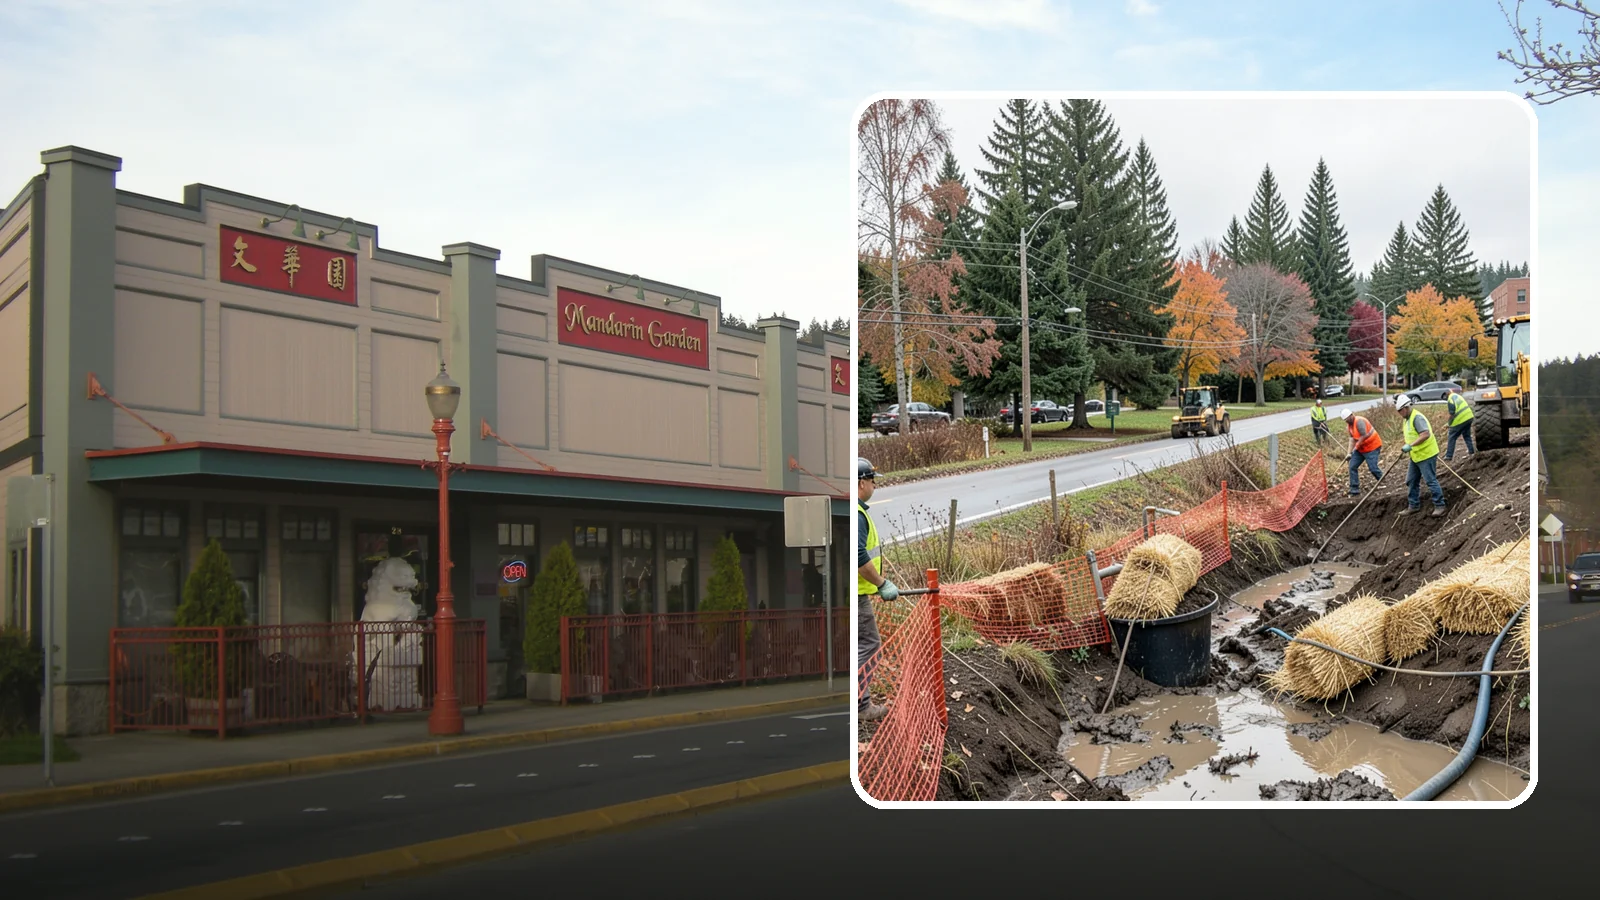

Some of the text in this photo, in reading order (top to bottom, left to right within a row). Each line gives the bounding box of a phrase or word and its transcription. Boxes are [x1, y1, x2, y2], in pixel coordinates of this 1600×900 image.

[230, 235, 347, 292] 文華園
[564, 302, 701, 352] Mandarin Garden
[835, 363, 846, 386] 文
[503, 565, 527, 578] OPEN
